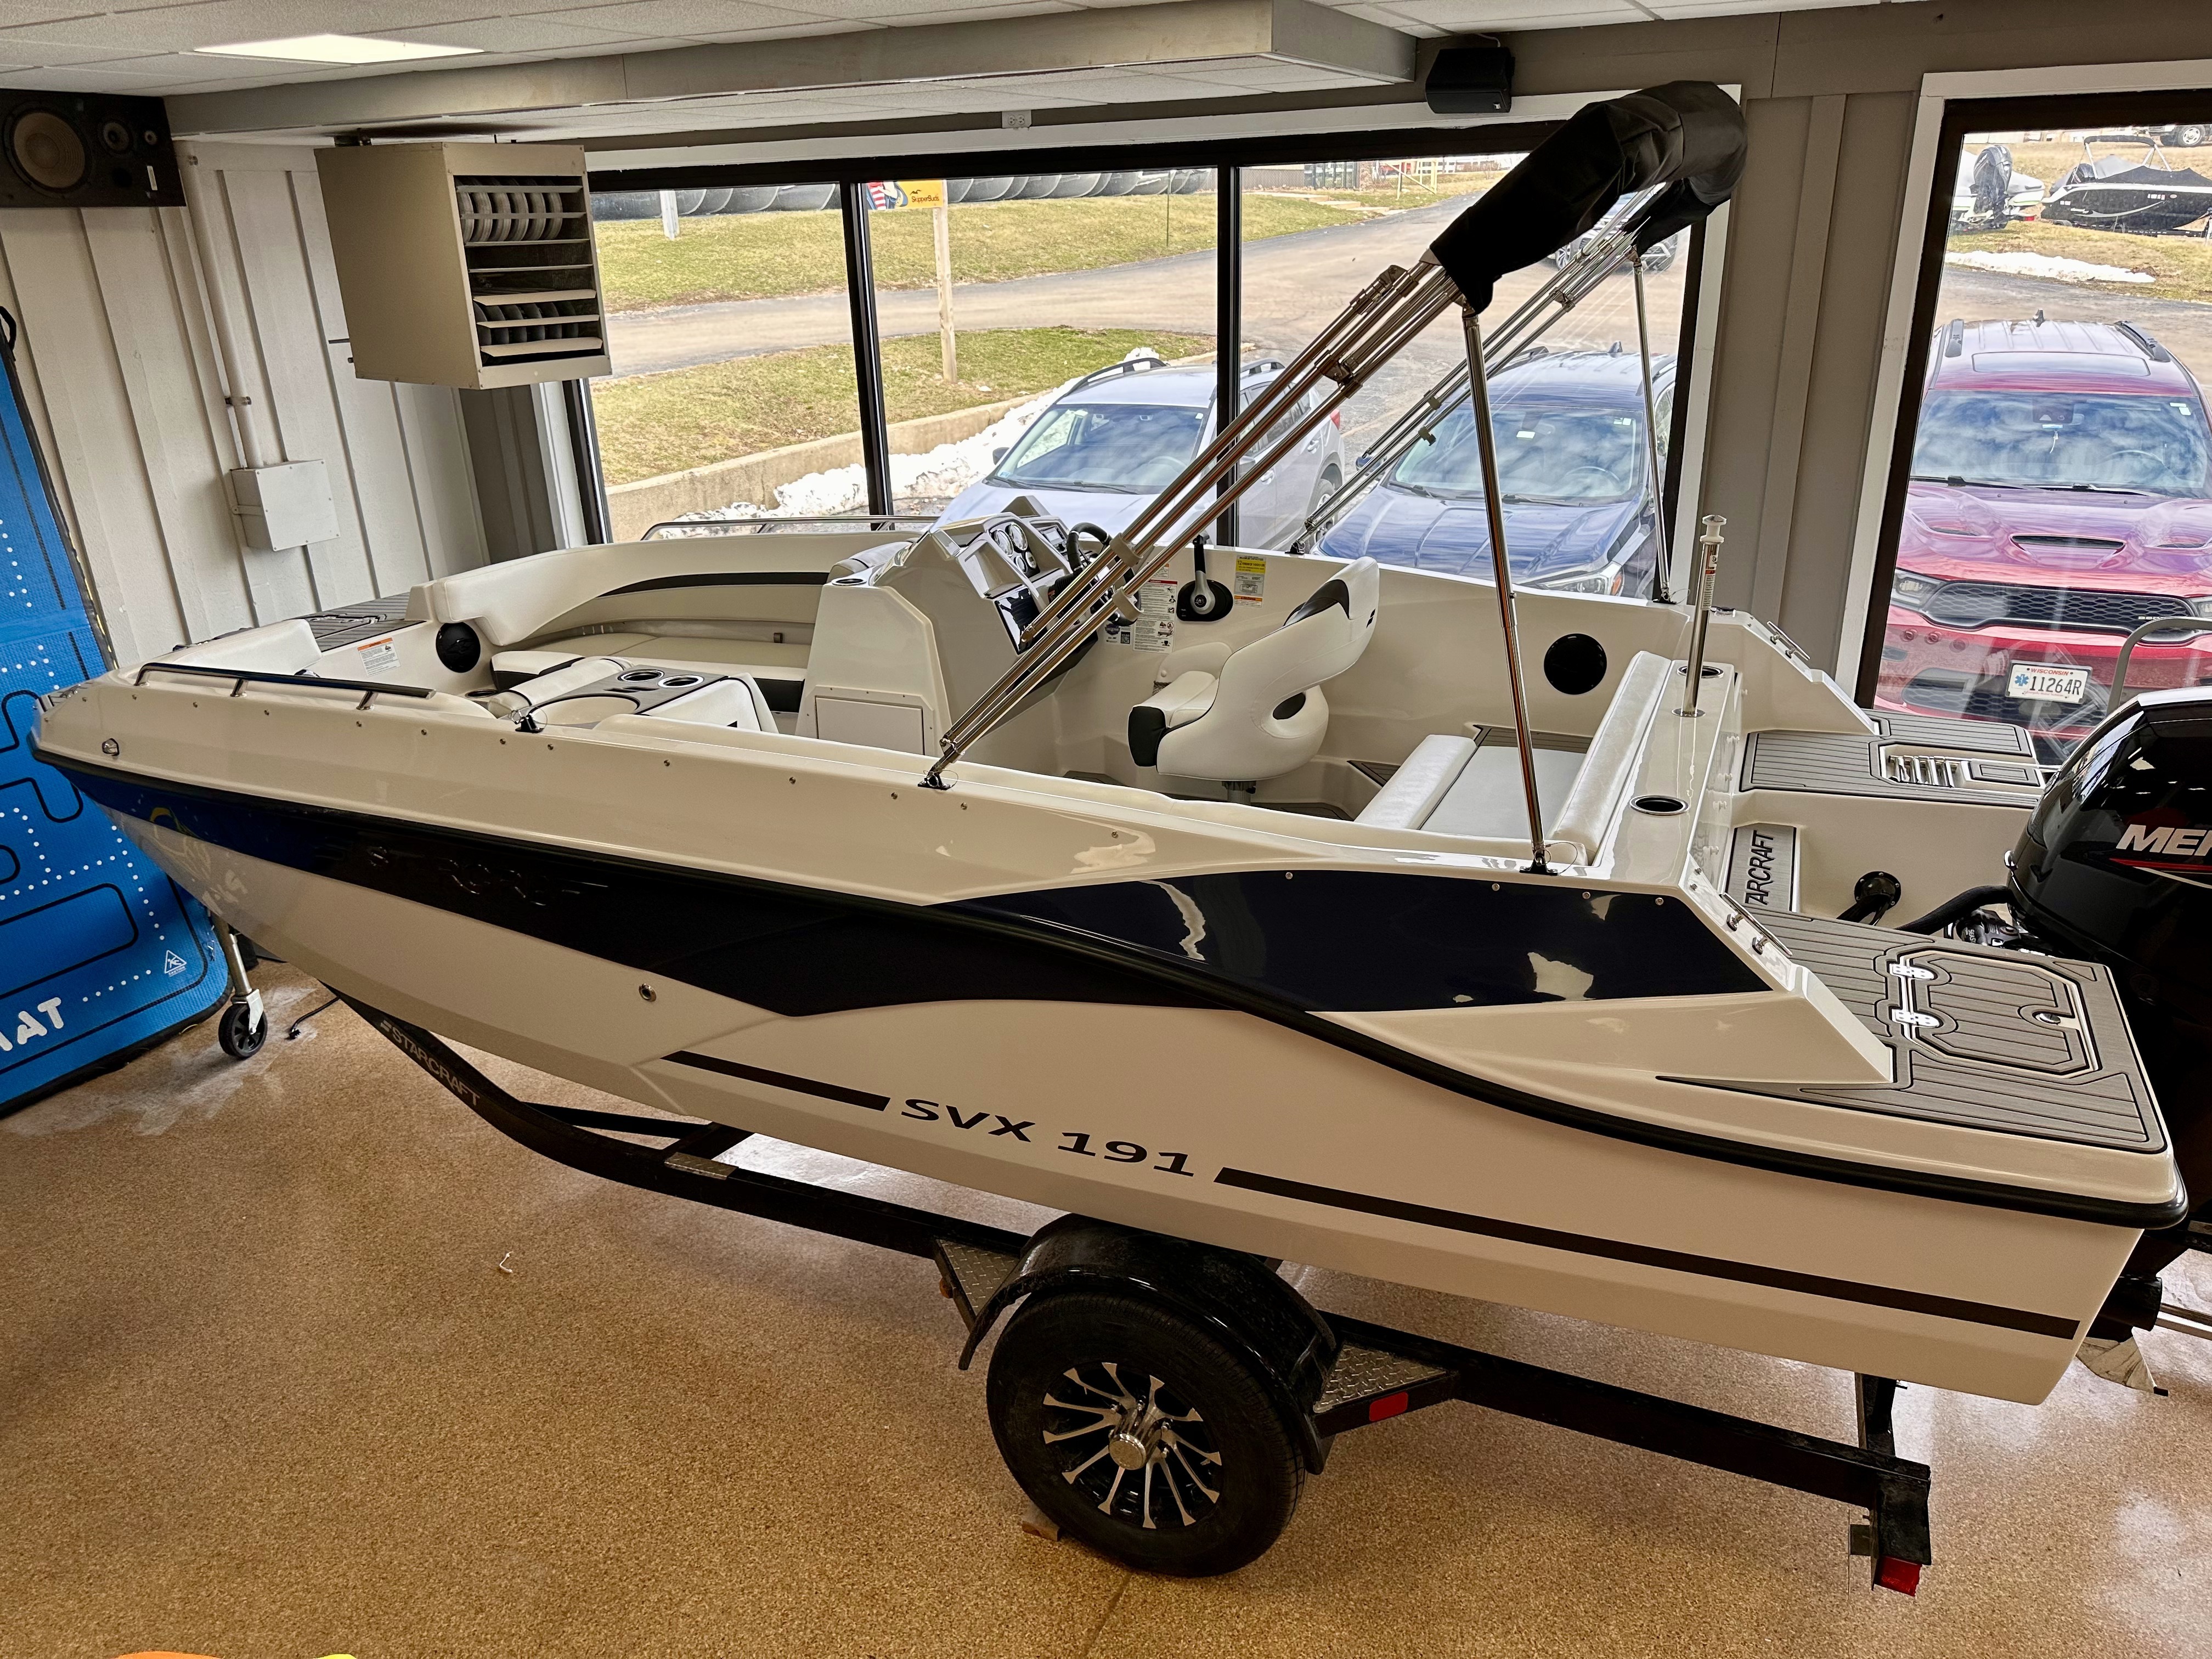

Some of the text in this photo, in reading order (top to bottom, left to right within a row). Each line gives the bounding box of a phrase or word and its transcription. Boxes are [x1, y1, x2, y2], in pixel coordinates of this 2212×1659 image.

[2029, 676, 2082, 695] 11264R
[2031, 668, 2069, 676] WISCONSIN
[392, 1026, 481, 1105] STARCRAFT
[901, 1098, 1194, 1177] SVX 191
